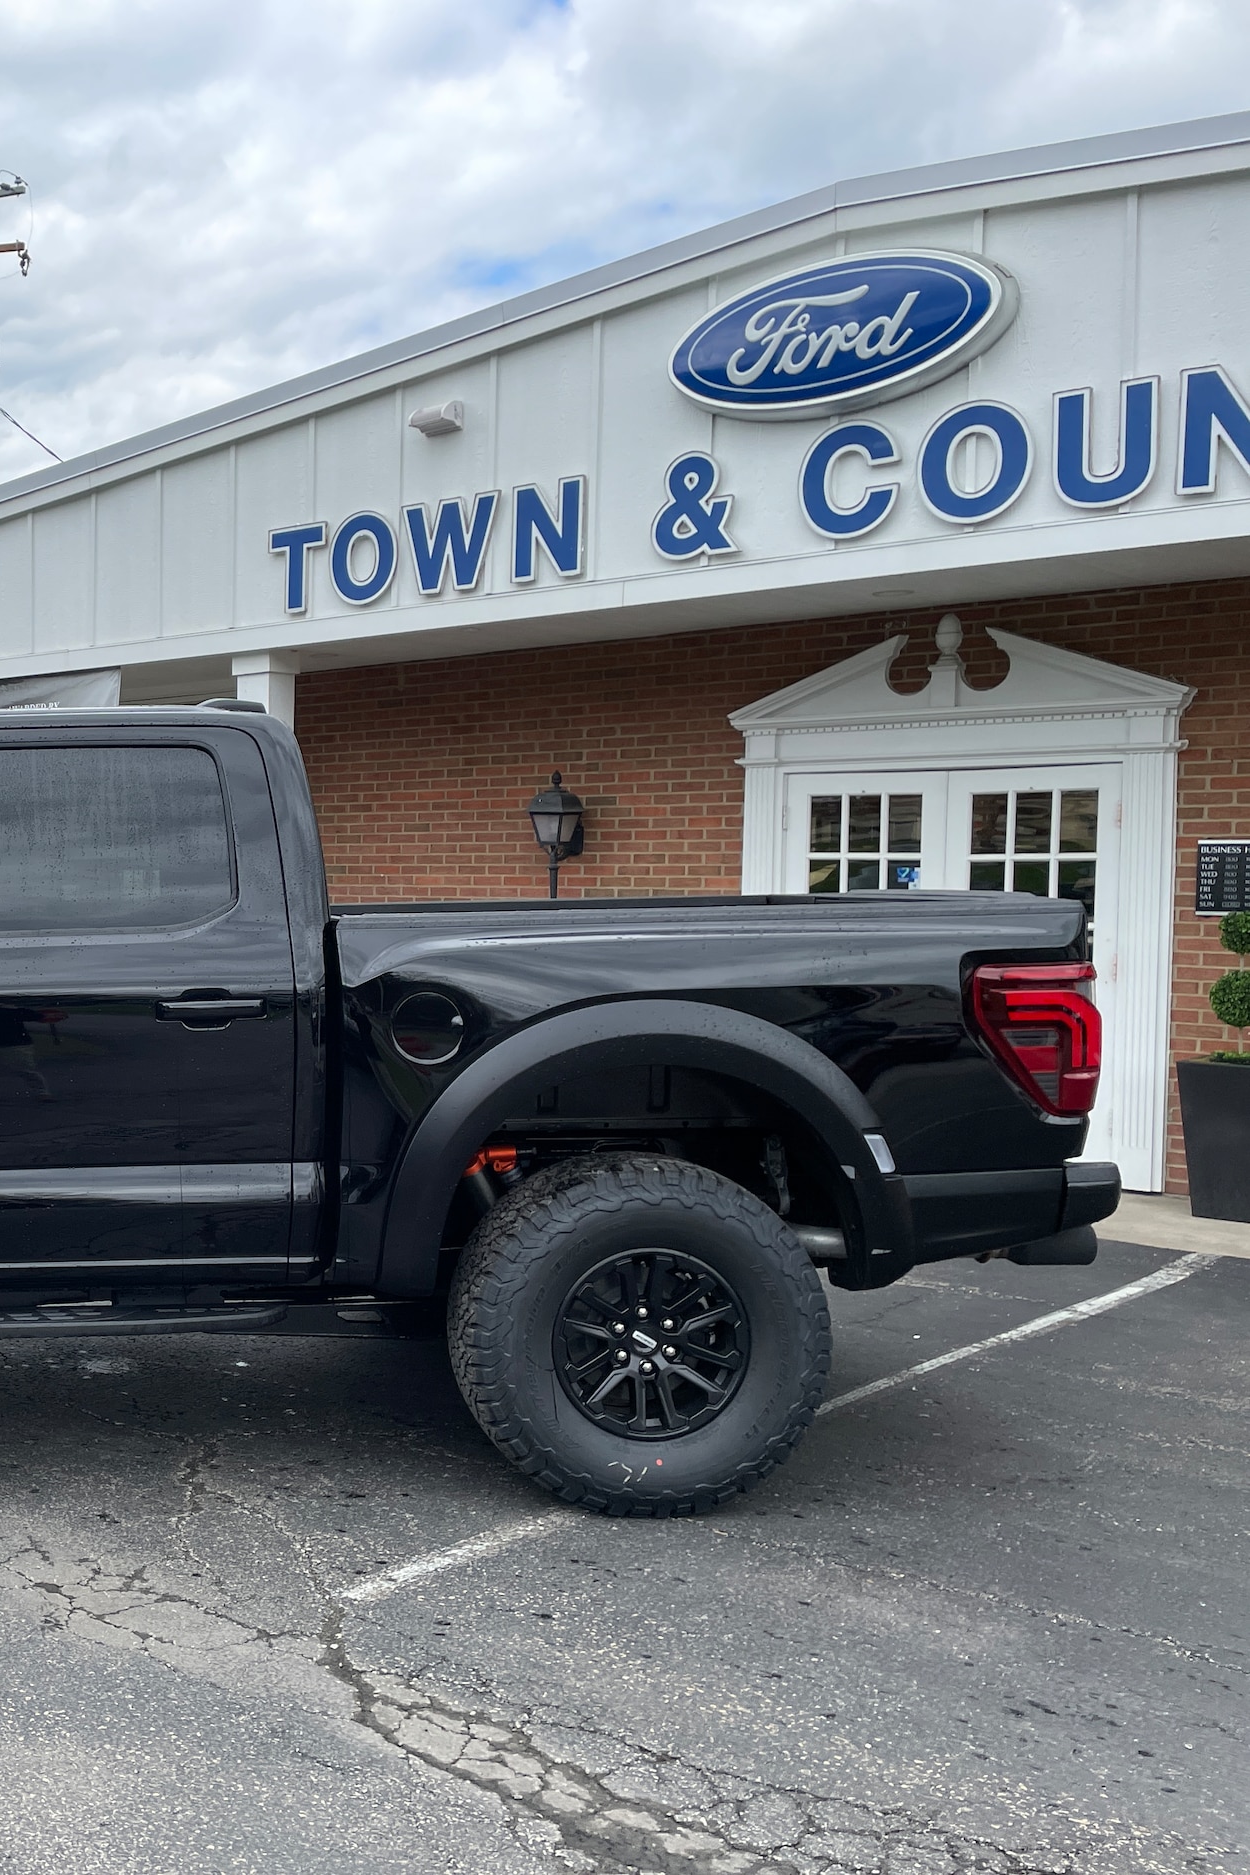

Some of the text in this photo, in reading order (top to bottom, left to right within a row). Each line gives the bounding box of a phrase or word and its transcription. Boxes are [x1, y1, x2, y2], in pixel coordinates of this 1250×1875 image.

[726, 284, 921, 386] Ford
[268, 474, 588, 614] TOWN
[650, 451, 742, 561] &
[1201, 846, 1242, 854] BUSINESS
